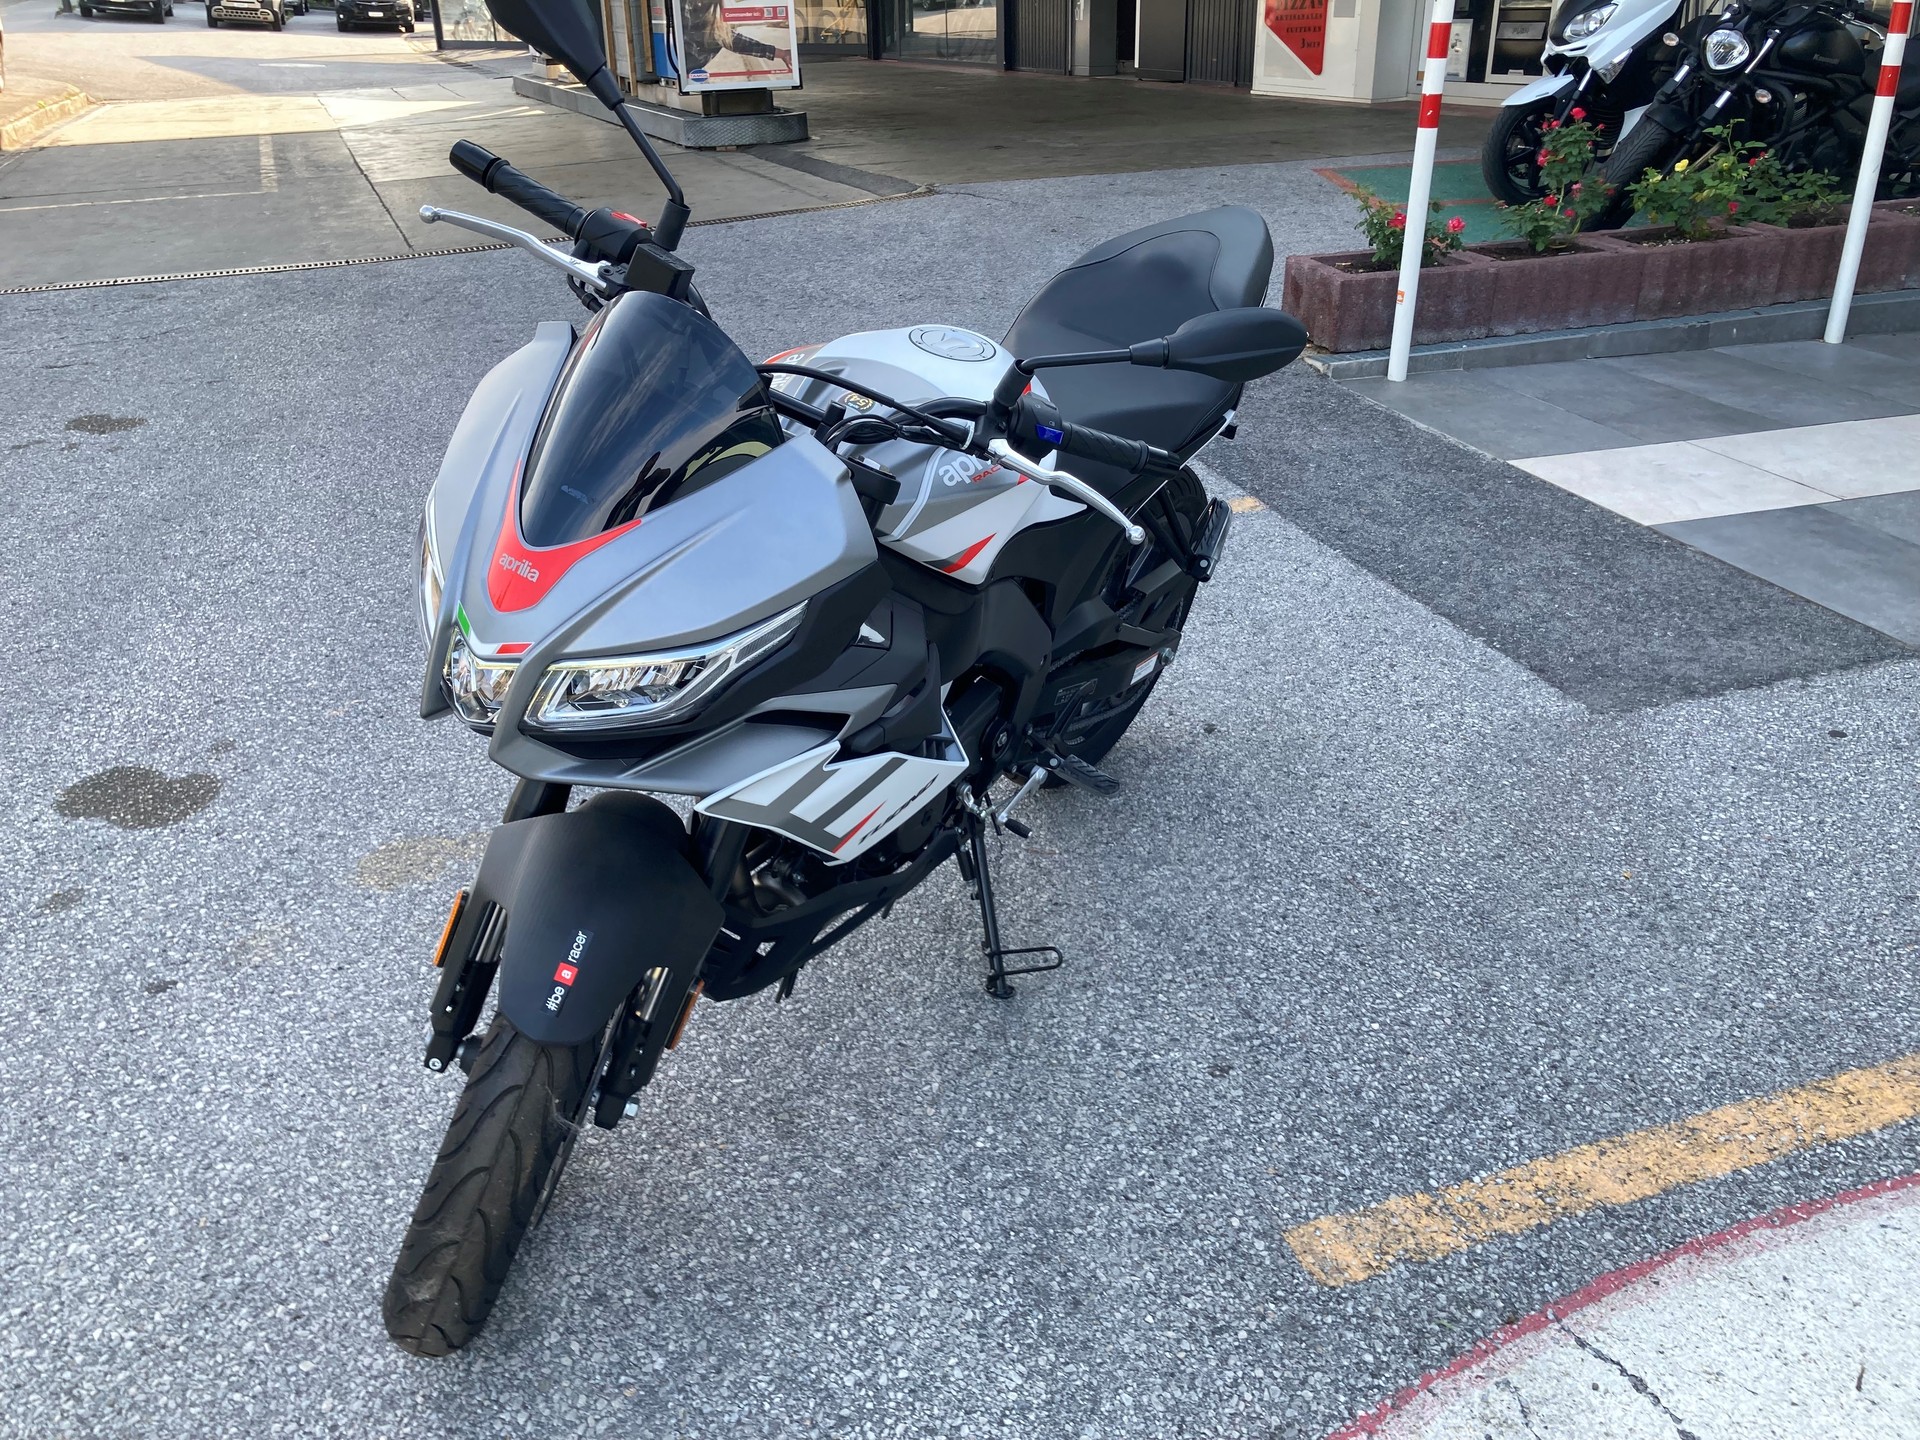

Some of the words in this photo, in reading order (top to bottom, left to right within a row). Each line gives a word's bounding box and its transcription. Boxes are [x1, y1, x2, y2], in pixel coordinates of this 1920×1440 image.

[499, 553, 540, 583] aprilia
[545, 986, 565, 1011] #be
[561, 969, 573, 980] a
[567, 930, 588, 963] racer
